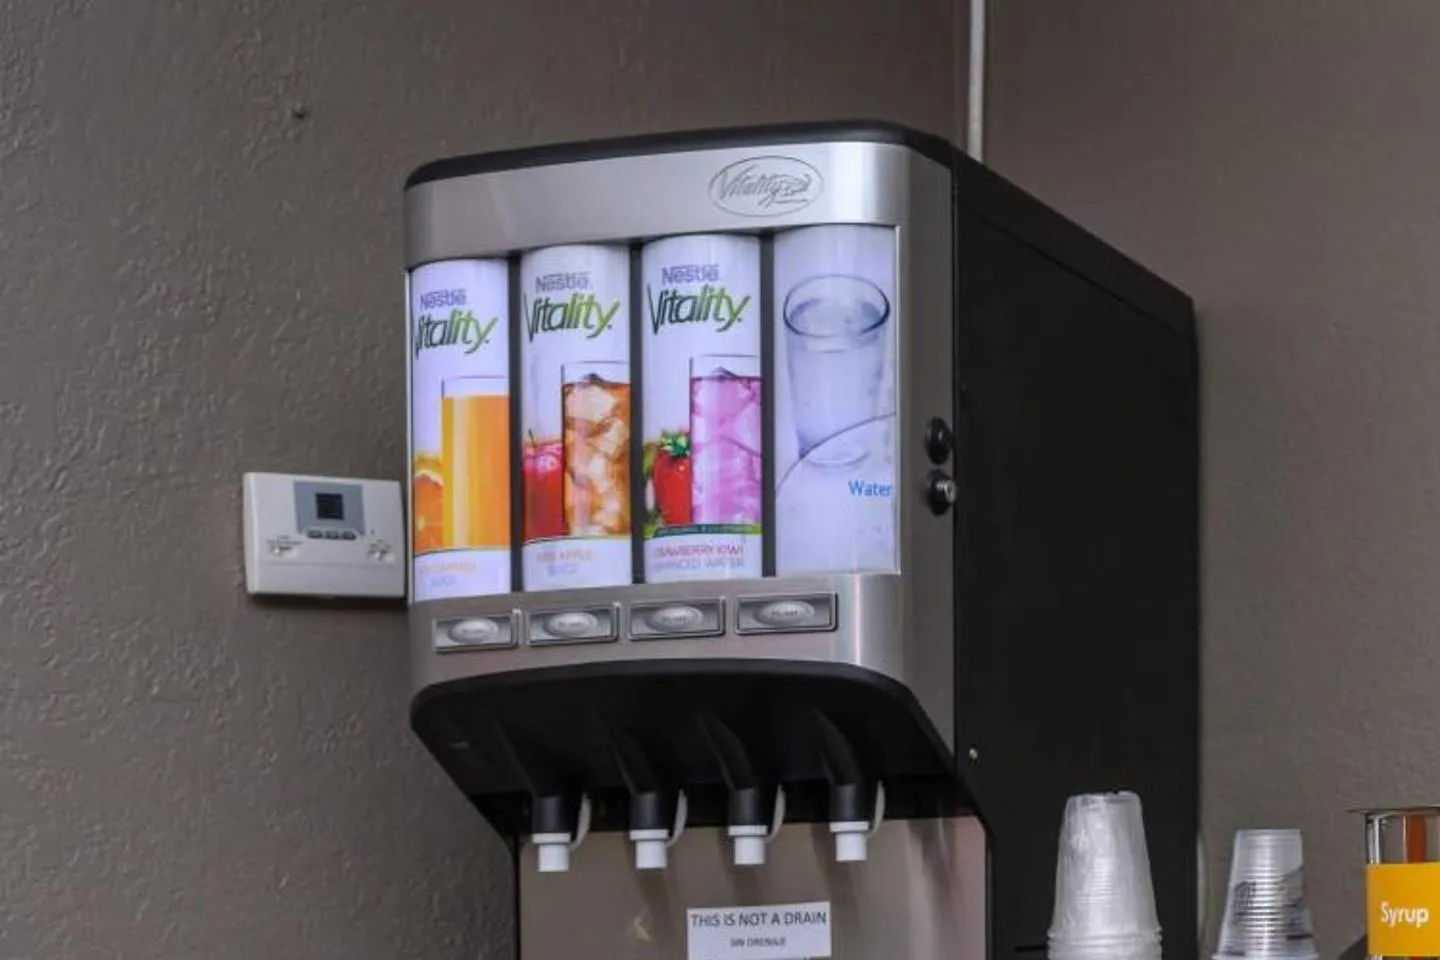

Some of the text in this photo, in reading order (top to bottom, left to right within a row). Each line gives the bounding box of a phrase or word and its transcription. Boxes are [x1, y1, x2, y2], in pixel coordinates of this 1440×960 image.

[523, 292, 621, 344] Vitality
[647, 284, 751, 336] Vitality
[848, 480, 892, 497] Water
[691, 911, 827, 927] THIS IS NOT A DRAIN
[1380, 901, 1430, 928] Syrup
